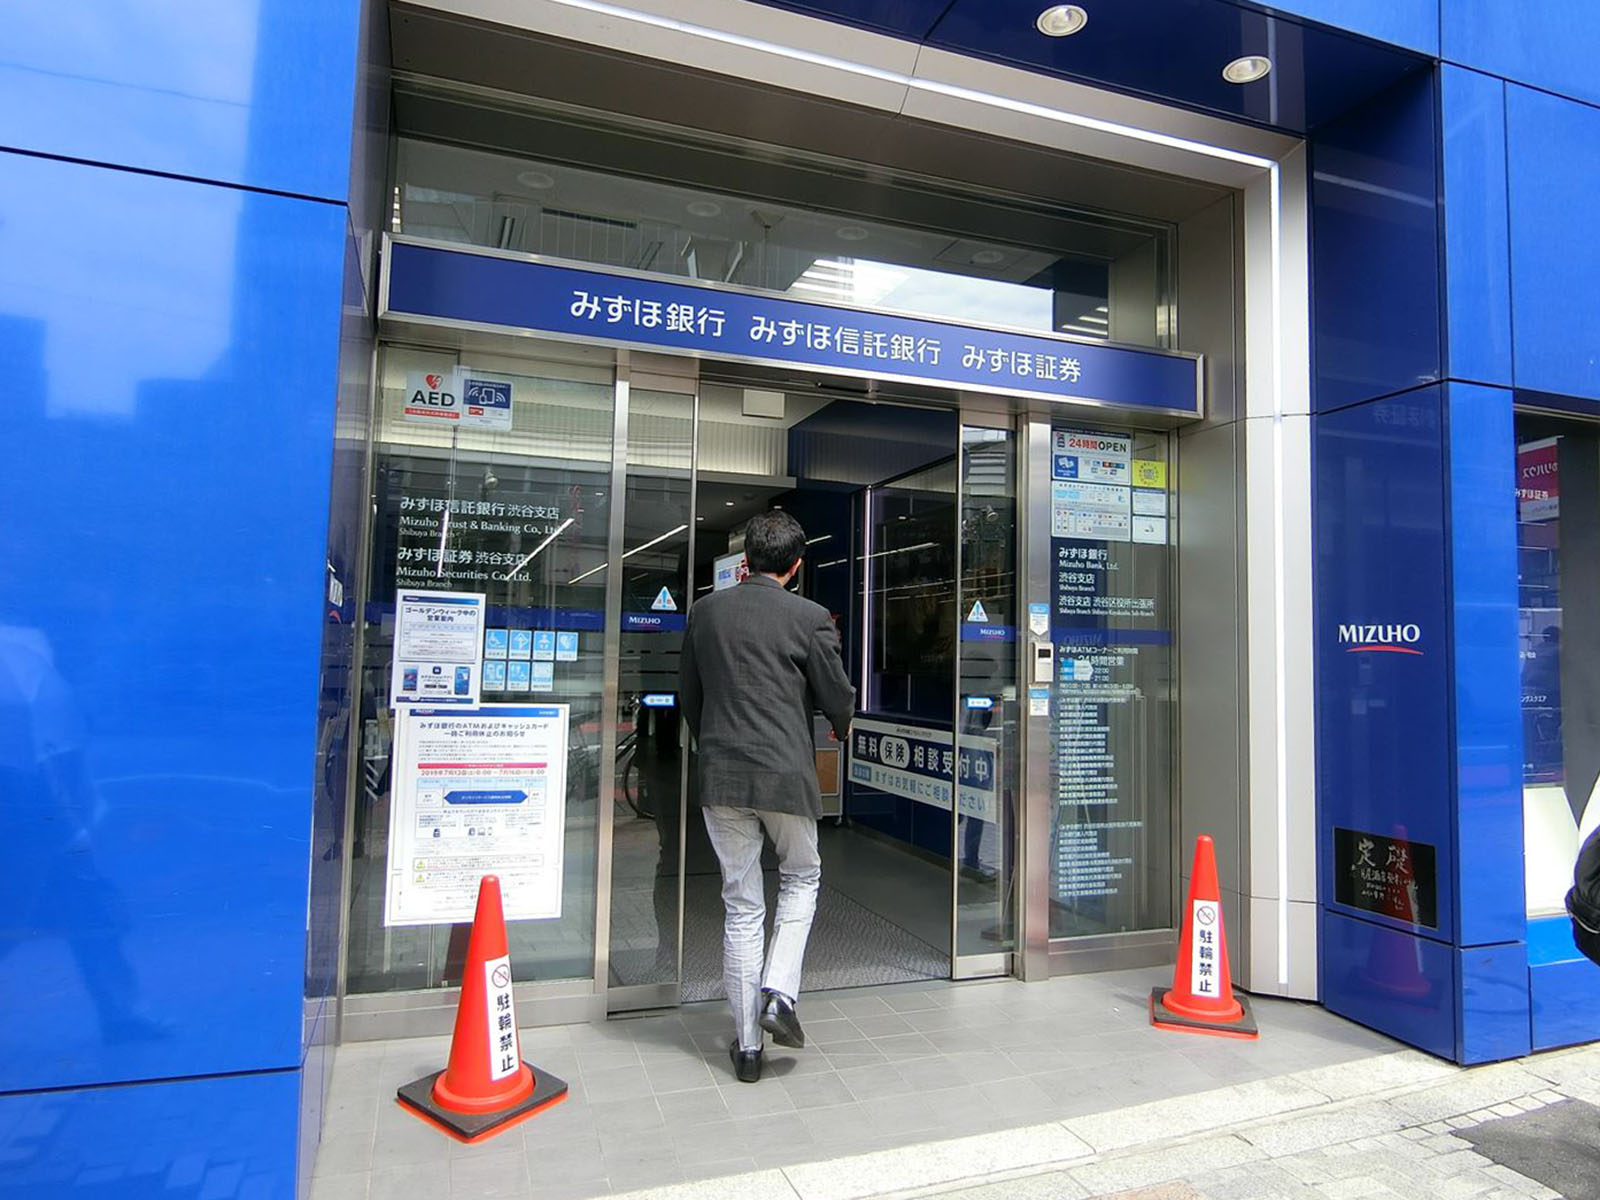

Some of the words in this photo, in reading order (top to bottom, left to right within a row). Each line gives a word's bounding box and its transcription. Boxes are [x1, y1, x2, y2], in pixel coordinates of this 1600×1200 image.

[570, 290, 726, 338] みずほ銀行
[750, 315, 942, 366] みずほ信託銀行
[962, 344, 1081, 383] みずほ証券
[411, 390, 455, 407] AED
[400, 496, 506, 517] みずほ信託銀行
[507, 503, 560, 520] 渋谷支店
[399, 528, 428, 538] Shibuya
[400, 516, 440, 527] Mizuho
[470, 520, 479, 530] &
[481, 521, 521, 535] Banking
[397, 547, 473, 564] みずほ証券
[475, 551, 528, 567] 渋谷支店
[1058, 547, 1108, 560] みずほ銀行
[396, 567, 437, 578] Mizuho
[440, 568, 489, 580] Securities
[513, 571, 532, 582] Ltd.
[1058, 572, 1095, 584] 渋谷支店
[628, 616, 661, 625] MIZUHO
[1338, 624, 1420, 643] MIZUHO
[875, 771, 986, 811] まずはお気軽にご相談ださい
[1199, 929, 1213, 993] 駐輪禁止
[497, 992, 515, 1072] 駐輪禁止
